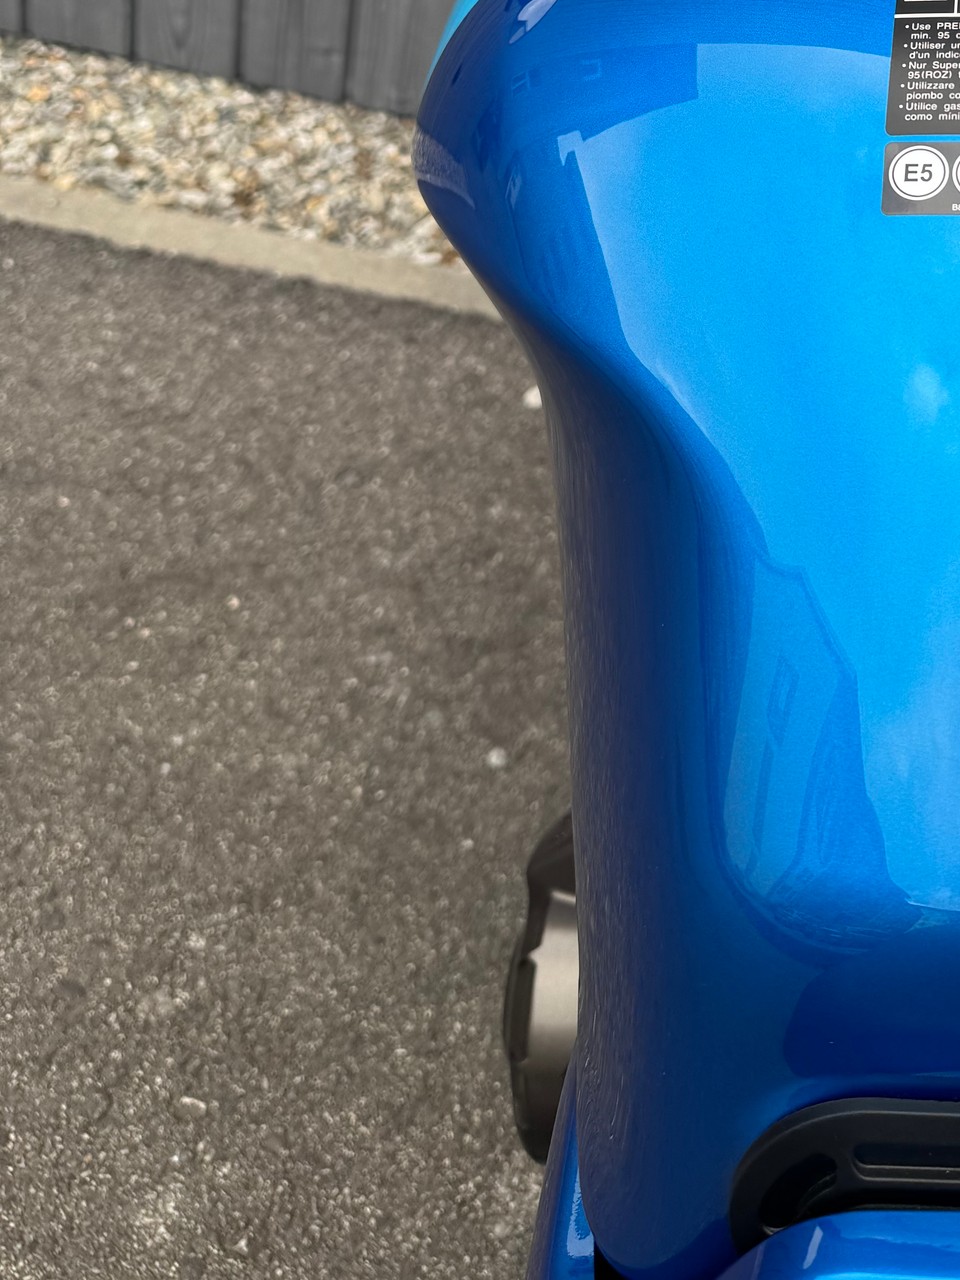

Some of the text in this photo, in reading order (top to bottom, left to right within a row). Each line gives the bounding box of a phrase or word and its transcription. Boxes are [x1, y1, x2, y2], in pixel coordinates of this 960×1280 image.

[911, 23, 931, 31] Use
[938, 31, 950, 39] 95
[910, 42, 945, 50] Utiliser
[909, 51, 930, 59] d'un
[908, 61, 927, 70] Nur
[908, 70, 953, 80] 95(ROZ)
[907, 81, 955, 89] Utilizzare
[906, 91, 944, 101] plombo
[906, 102, 937, 110] Utilice
[904, 113, 933, 121] como
[904, 163, 933, 182] E5
